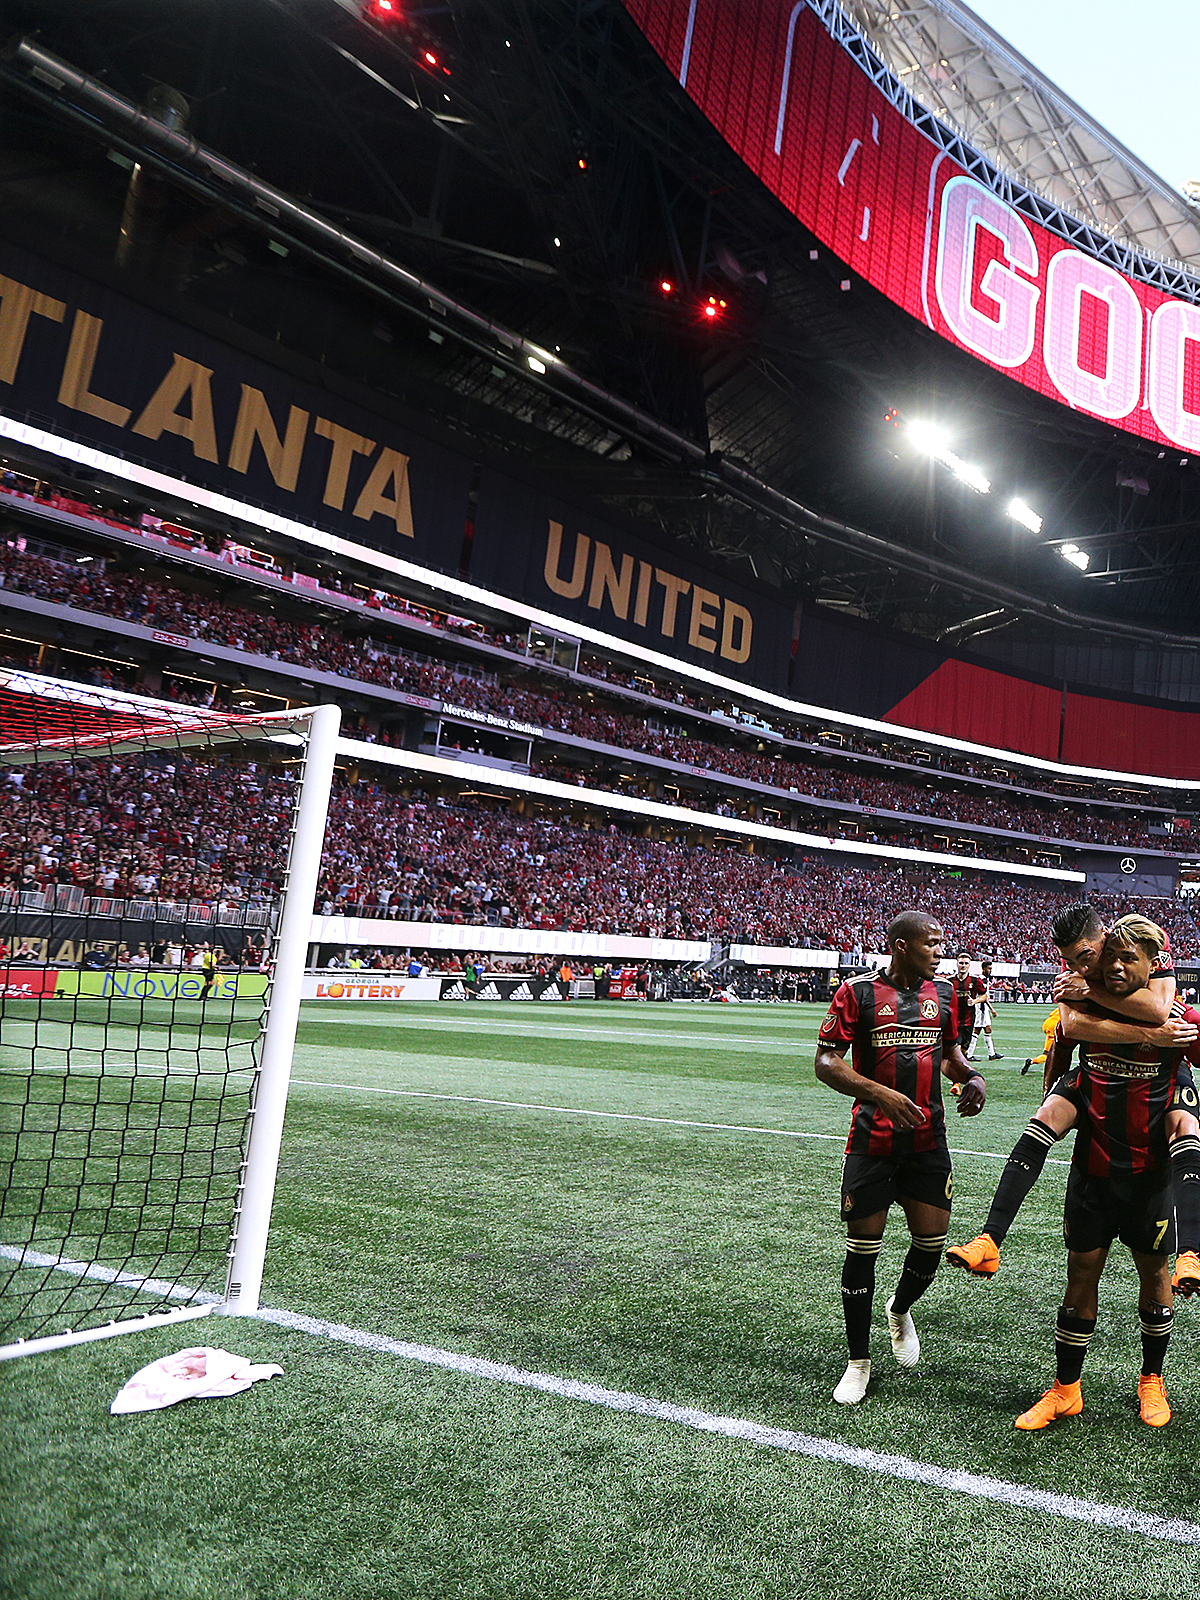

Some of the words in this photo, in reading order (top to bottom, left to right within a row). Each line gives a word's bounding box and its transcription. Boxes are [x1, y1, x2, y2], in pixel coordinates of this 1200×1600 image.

[543, 518, 753, 664] UNITED
[442, 702, 508, 728] Mercedes-Benz
[508, 719, 543, 737] Stadium
[1177, 973, 1198, 982] UNITED
[102, 972, 237, 998] Noveis
[316, 984, 405, 998] LOTTERY
[871, 1032, 912, 1040] AMERICAN
[914, 1031, 940, 1039] FAMILY
[1129, 1064, 1159, 1073] FAMILY
[1173, 1085, 1197, 1107] 10
[1183, 1173, 1200, 1181] ATL
[1156, 1218, 1169, 1250] 7
[852, 1287, 867, 1295] UTD
